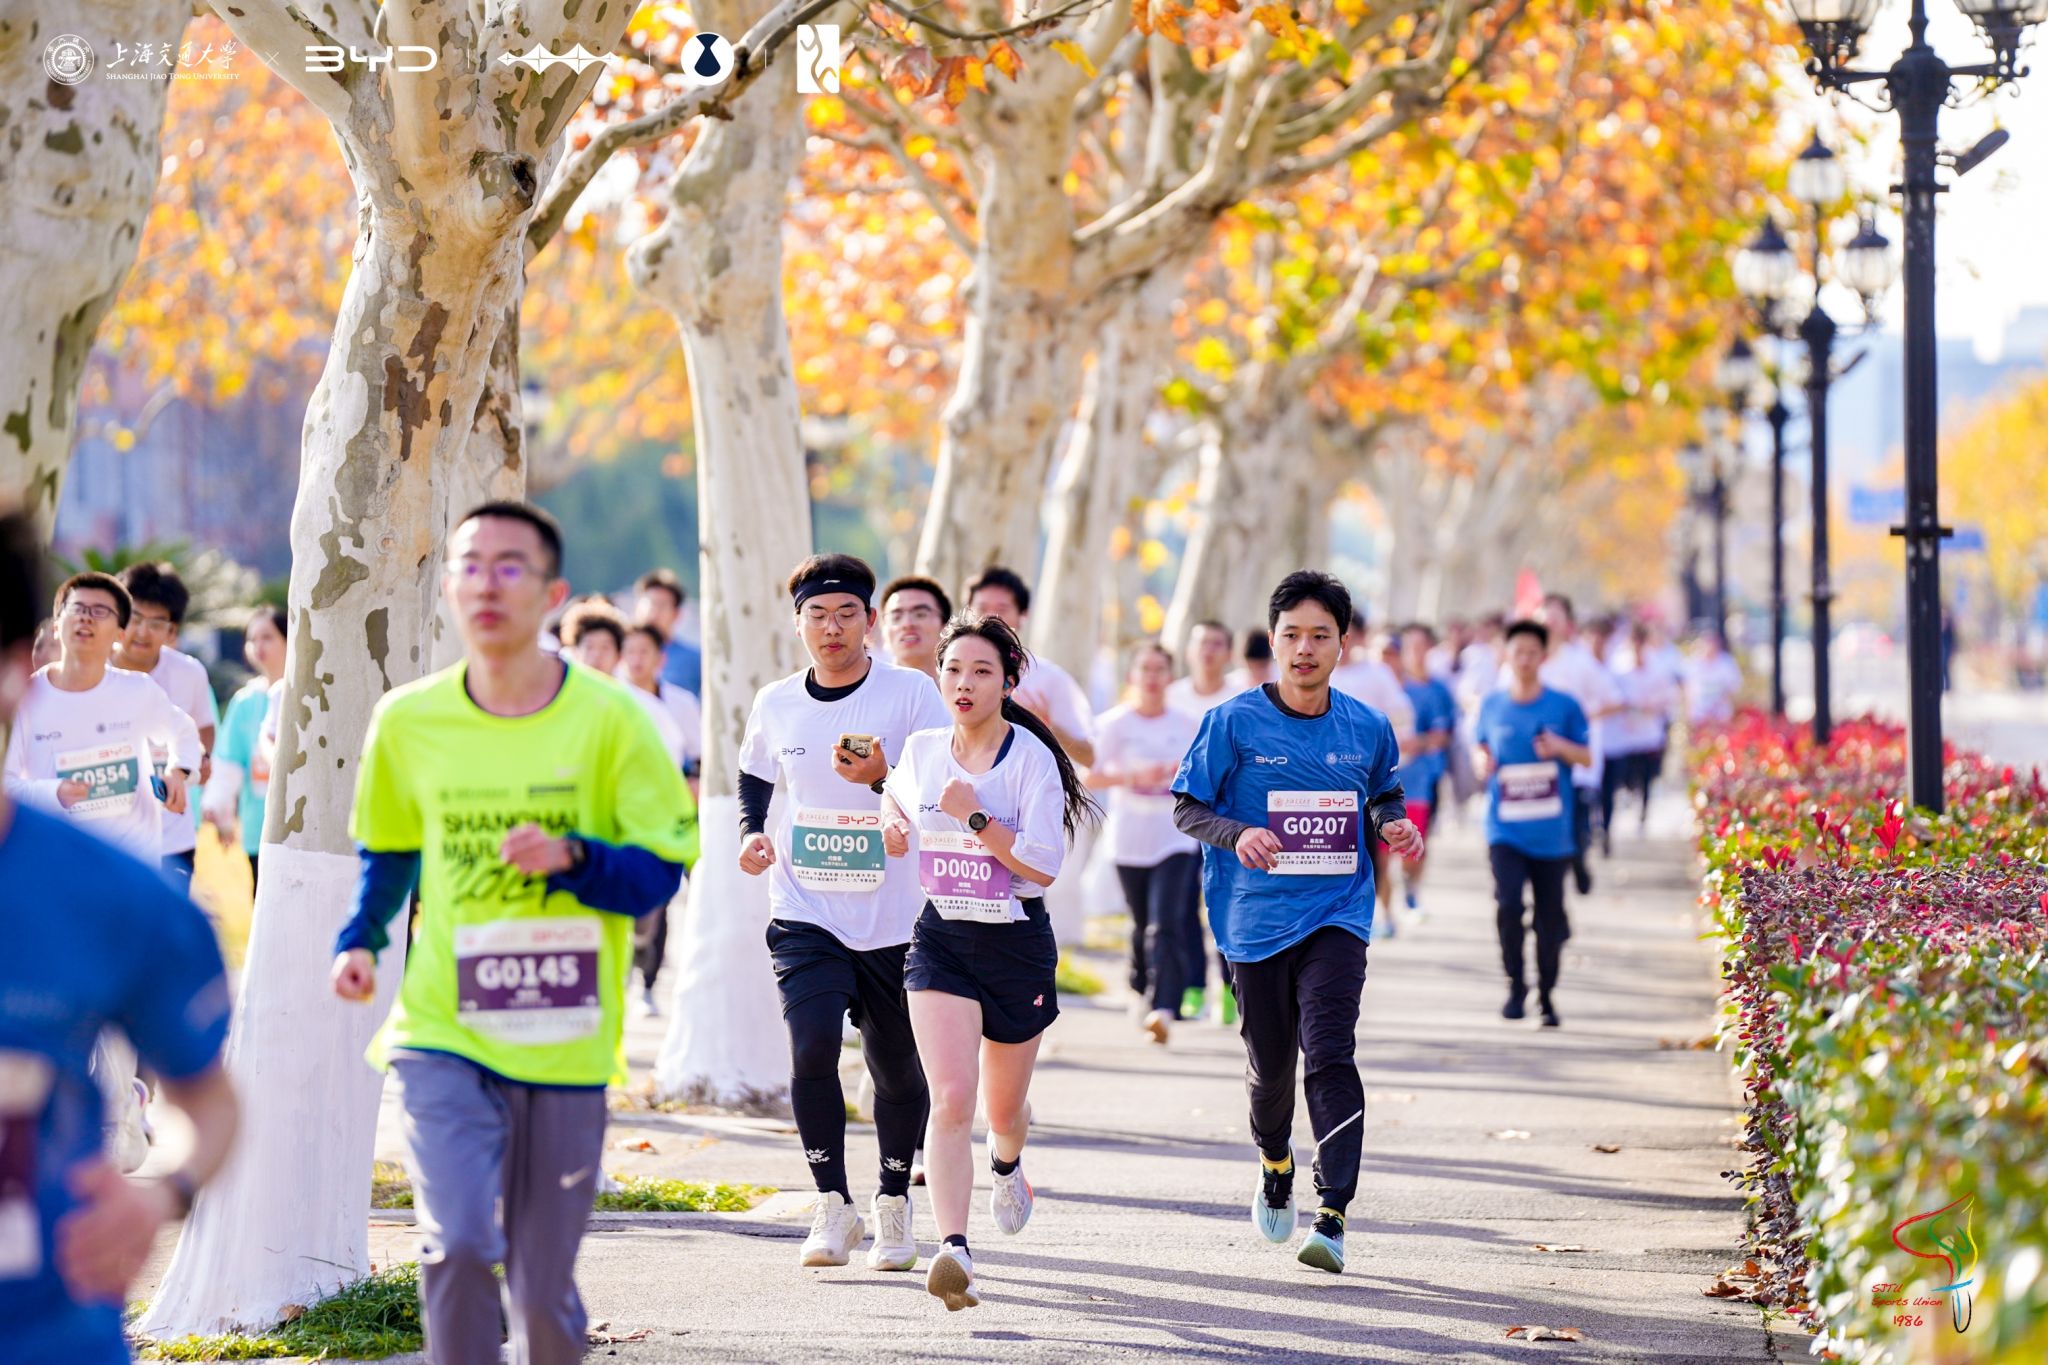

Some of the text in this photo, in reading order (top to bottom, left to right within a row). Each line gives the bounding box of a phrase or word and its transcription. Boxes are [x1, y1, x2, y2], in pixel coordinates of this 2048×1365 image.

[1255, 755, 1288, 765] BYD
[1318, 798, 1354, 807] BYD
[837, 815, 879, 825] BYD
[1283, 816, 1348, 835] G0207
[804, 832, 869, 853] C0090
[933, 857, 992, 882] D0020
[475, 955, 580, 990] G0145
